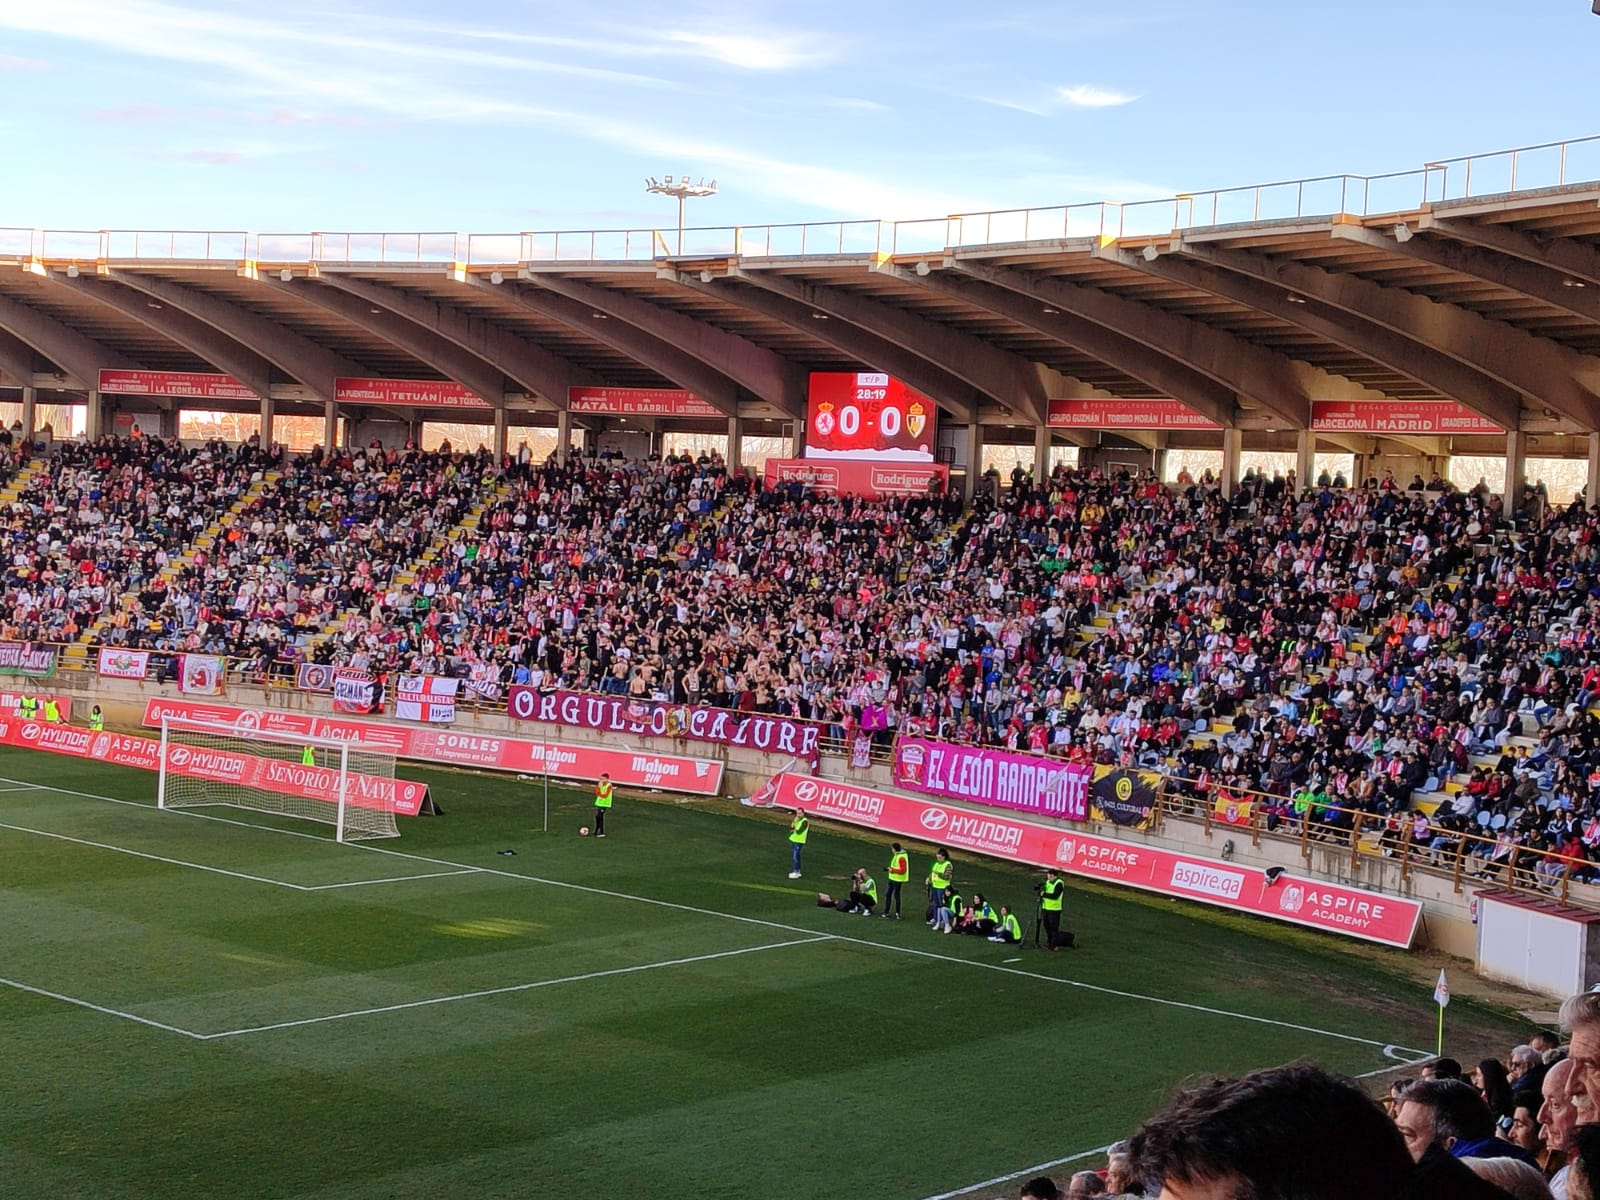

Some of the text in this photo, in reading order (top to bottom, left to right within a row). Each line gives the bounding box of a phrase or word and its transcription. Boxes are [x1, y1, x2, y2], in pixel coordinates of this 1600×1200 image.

[167, 386, 202, 395] LEONESA
[391, 392, 438, 402] TETUÁN
[857, 389, 886, 400] 28:19
[443, 396, 458, 404] LOS
[571, 402, 618, 410] NATAL
[624, 403, 670, 412] EL BARRIL
[840, 406, 860, 436] 0
[880, 406, 901, 436] 0
[1072, 412, 1100, 423] GUZMÁN
[1134, 412, 1158, 424] MORÁN
[1314, 418, 1367, 429] BARCELONA
[1376, 420, 1432, 430] MADRID
[338, 670, 376, 682] GRUPO
[437, 734, 500, 752] SORLES
[114, 753, 156, 766] ACADEMY
[532, 745, 576, 764] Mahou
[190, 752, 245, 774] HYUNDAI
[542, 762, 559, 772] SIN
[632, 756, 679, 776] Mahou
[266, 761, 330, 790] SEÑORÍO
[354, 774, 396, 802] NAVA
[644, 774, 662, 784] SIN
[927, 750, 1090, 816] EL LEÓN RAMPANTE
[820, 786, 885, 816] HYUNDAI
[950, 815, 1024, 846] HYUNDAI
[1077, 844, 1139, 866] ASPIRE
[1082, 859, 1128, 875] ACADEMY
[1174, 866, 1240, 894] aspire.qa
[1306, 891, 1385, 919] ASPIRE
[1312, 908, 1370, 928] ACADEMY
